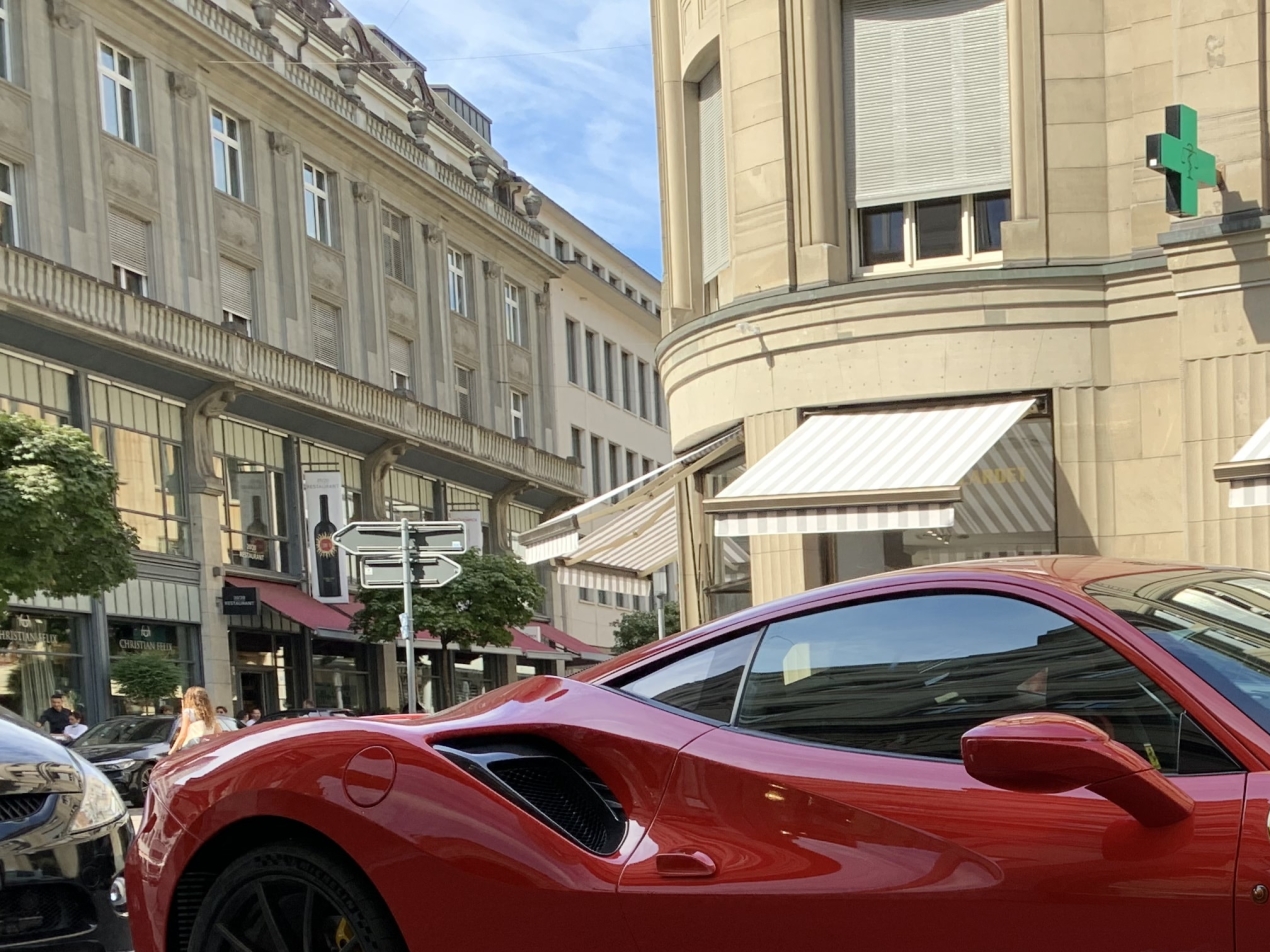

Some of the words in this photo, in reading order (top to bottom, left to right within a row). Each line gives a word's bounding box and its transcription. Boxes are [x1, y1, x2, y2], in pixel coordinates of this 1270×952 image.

[0, 630, 36, 643] HRISTIAN
[40, 633, 58, 644] FELIX
[119, 639, 155, 650] CHRISTIAN
[156, 642, 173, 651] FELIX
